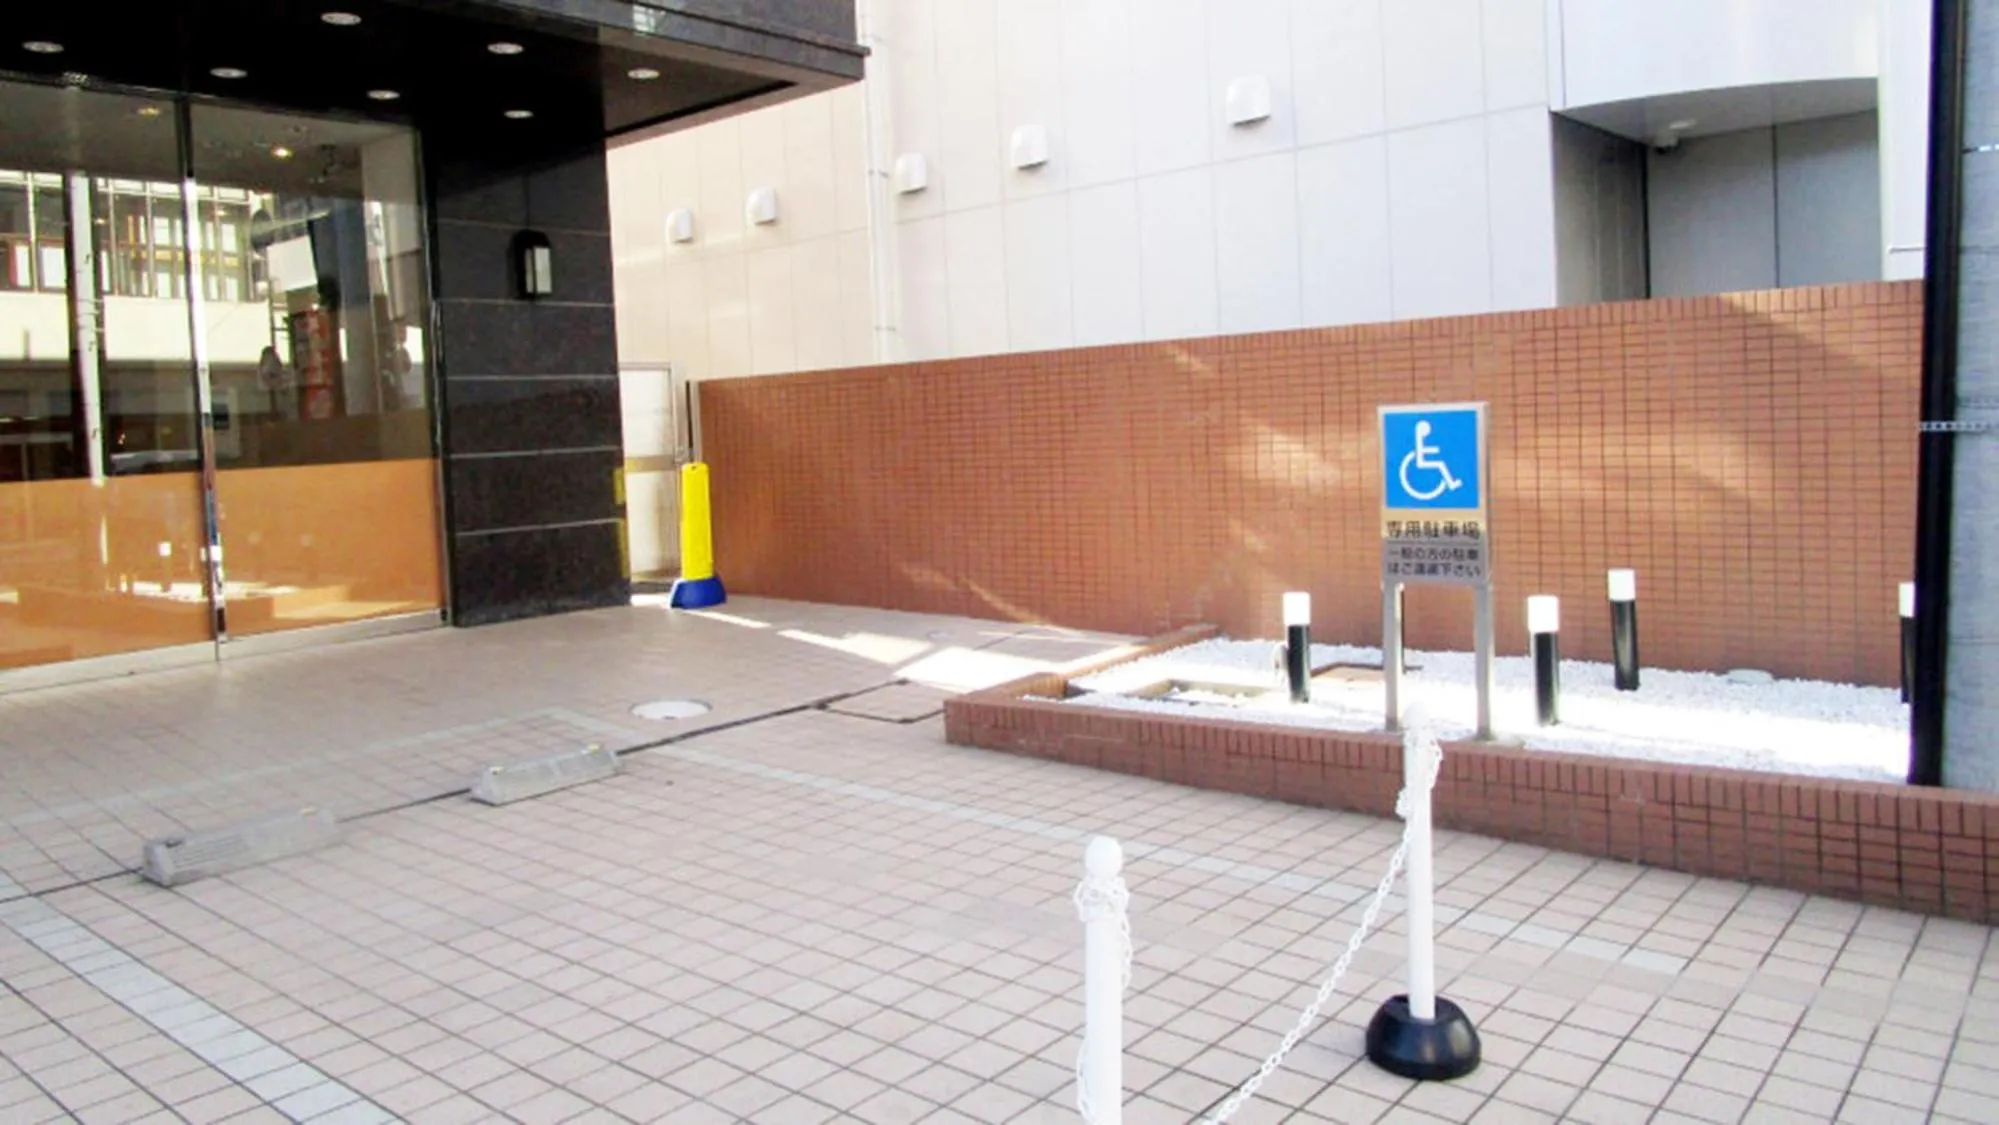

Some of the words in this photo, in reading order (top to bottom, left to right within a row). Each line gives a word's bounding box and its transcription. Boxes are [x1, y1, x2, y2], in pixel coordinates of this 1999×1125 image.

[1387, 521, 1480, 539] 専用駐車場
